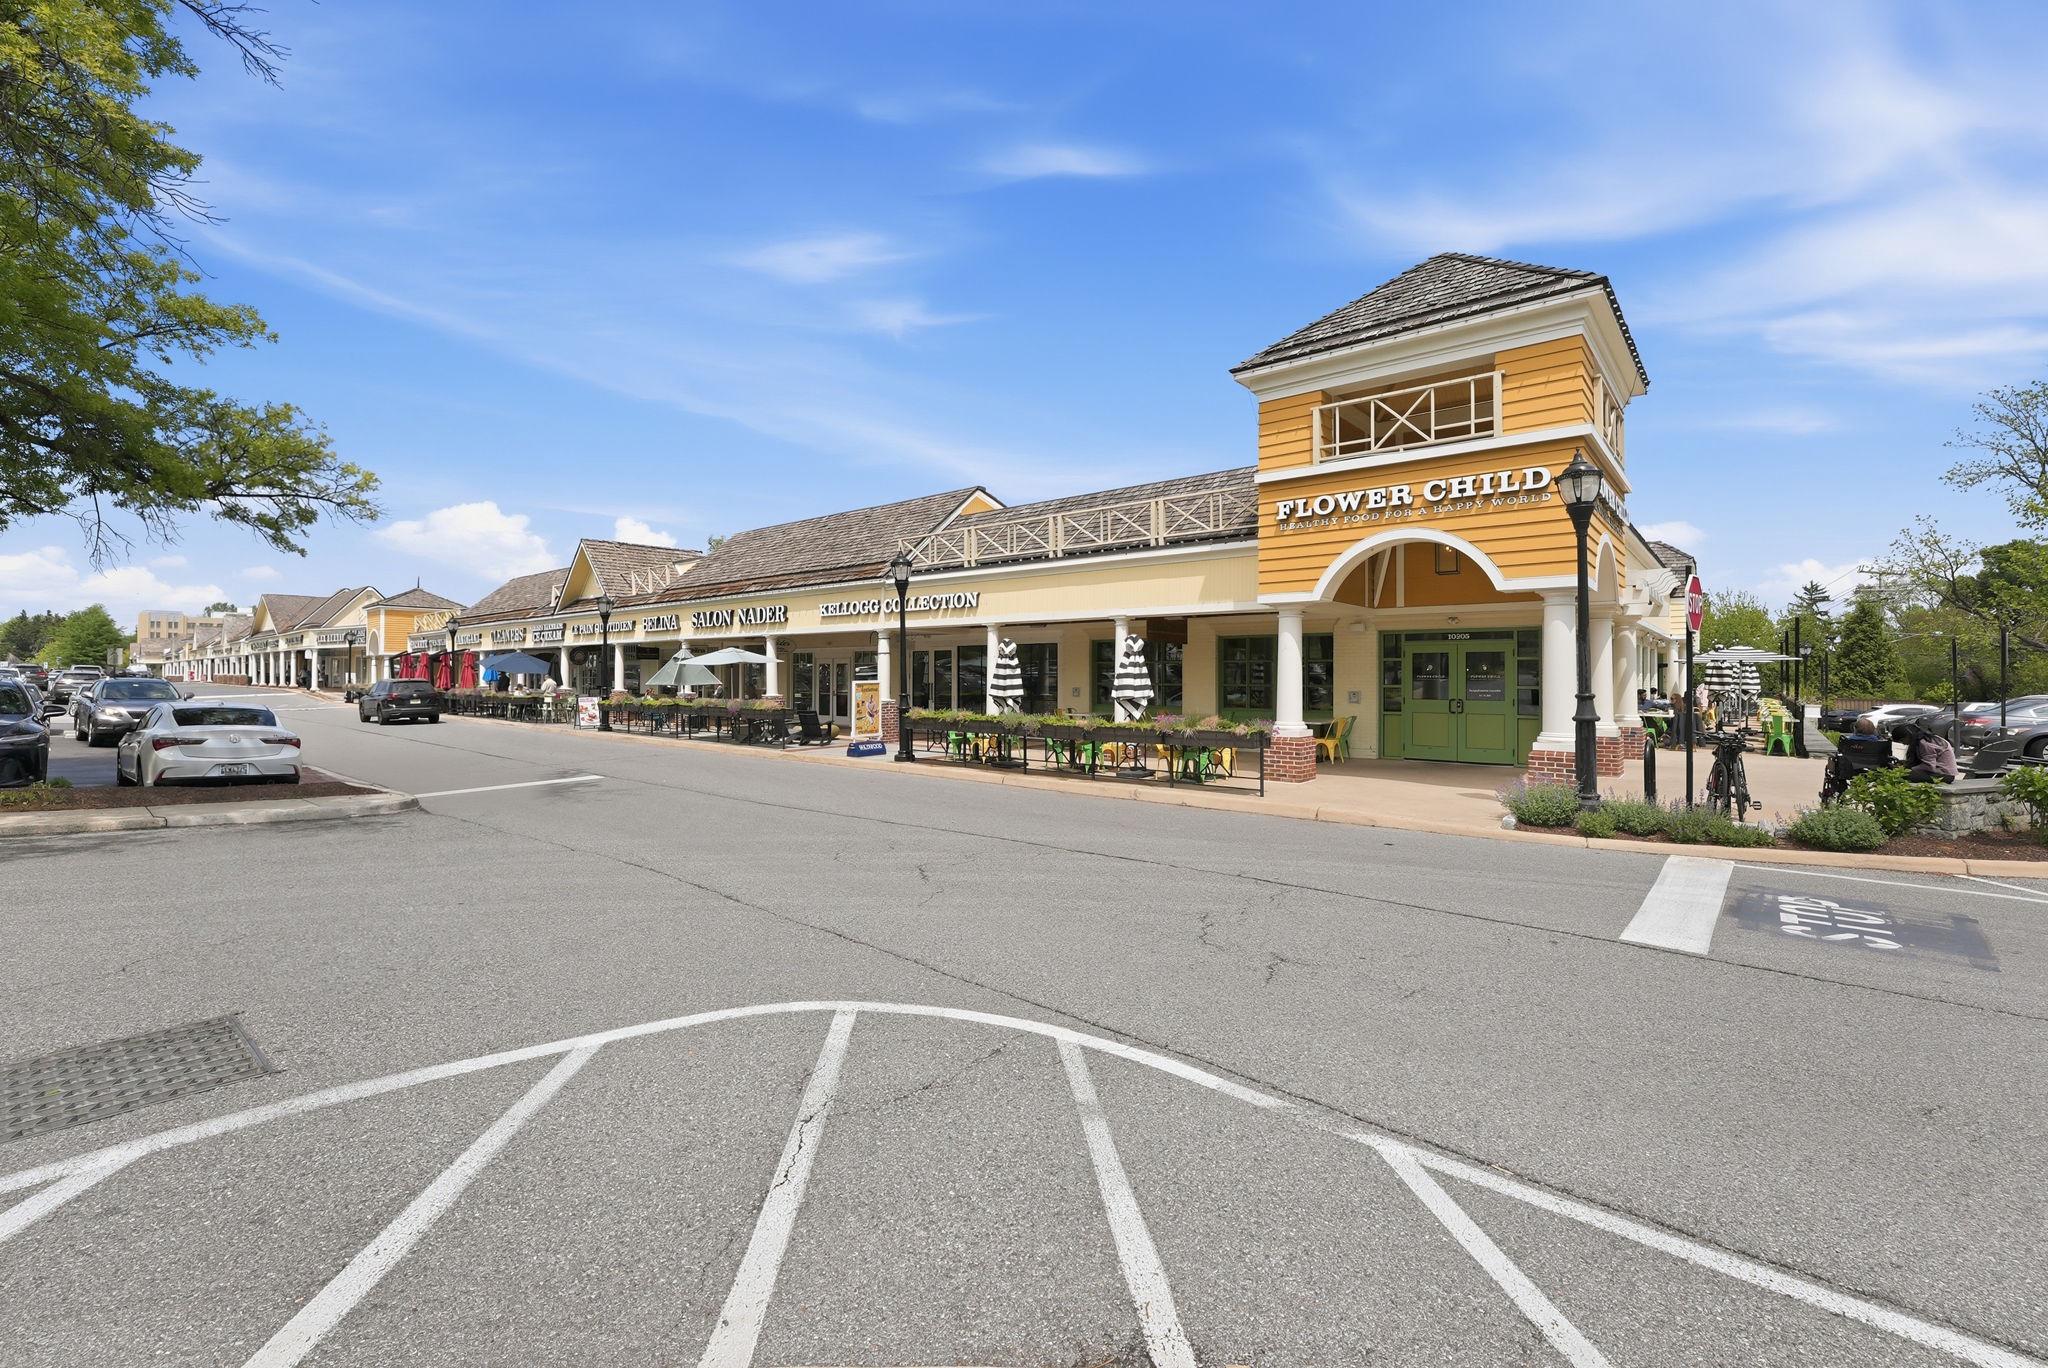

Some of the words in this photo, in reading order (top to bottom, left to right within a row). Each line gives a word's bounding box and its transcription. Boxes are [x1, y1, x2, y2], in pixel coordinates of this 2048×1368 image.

[1276, 484, 1413, 520] FLOWER
[1423, 466, 1552, 502] CHILD
[1279, 517, 1339, 531] HEALTHY
[1343, 513, 1380, 524] FOOD
[1385, 508, 1413, 519] FOR
[1418, 507, 1427, 515] A
[1433, 500, 1487, 513] HAPPY
[1491, 492, 1552, 507] WORLD
[819, 599, 880, 617] KELLOGG
[1689, 592, 1703, 614] STOP
[643, 614, 678, 631] BELINA
[691, 609, 733, 628] SALON
[737, 605, 786, 625] NADER
